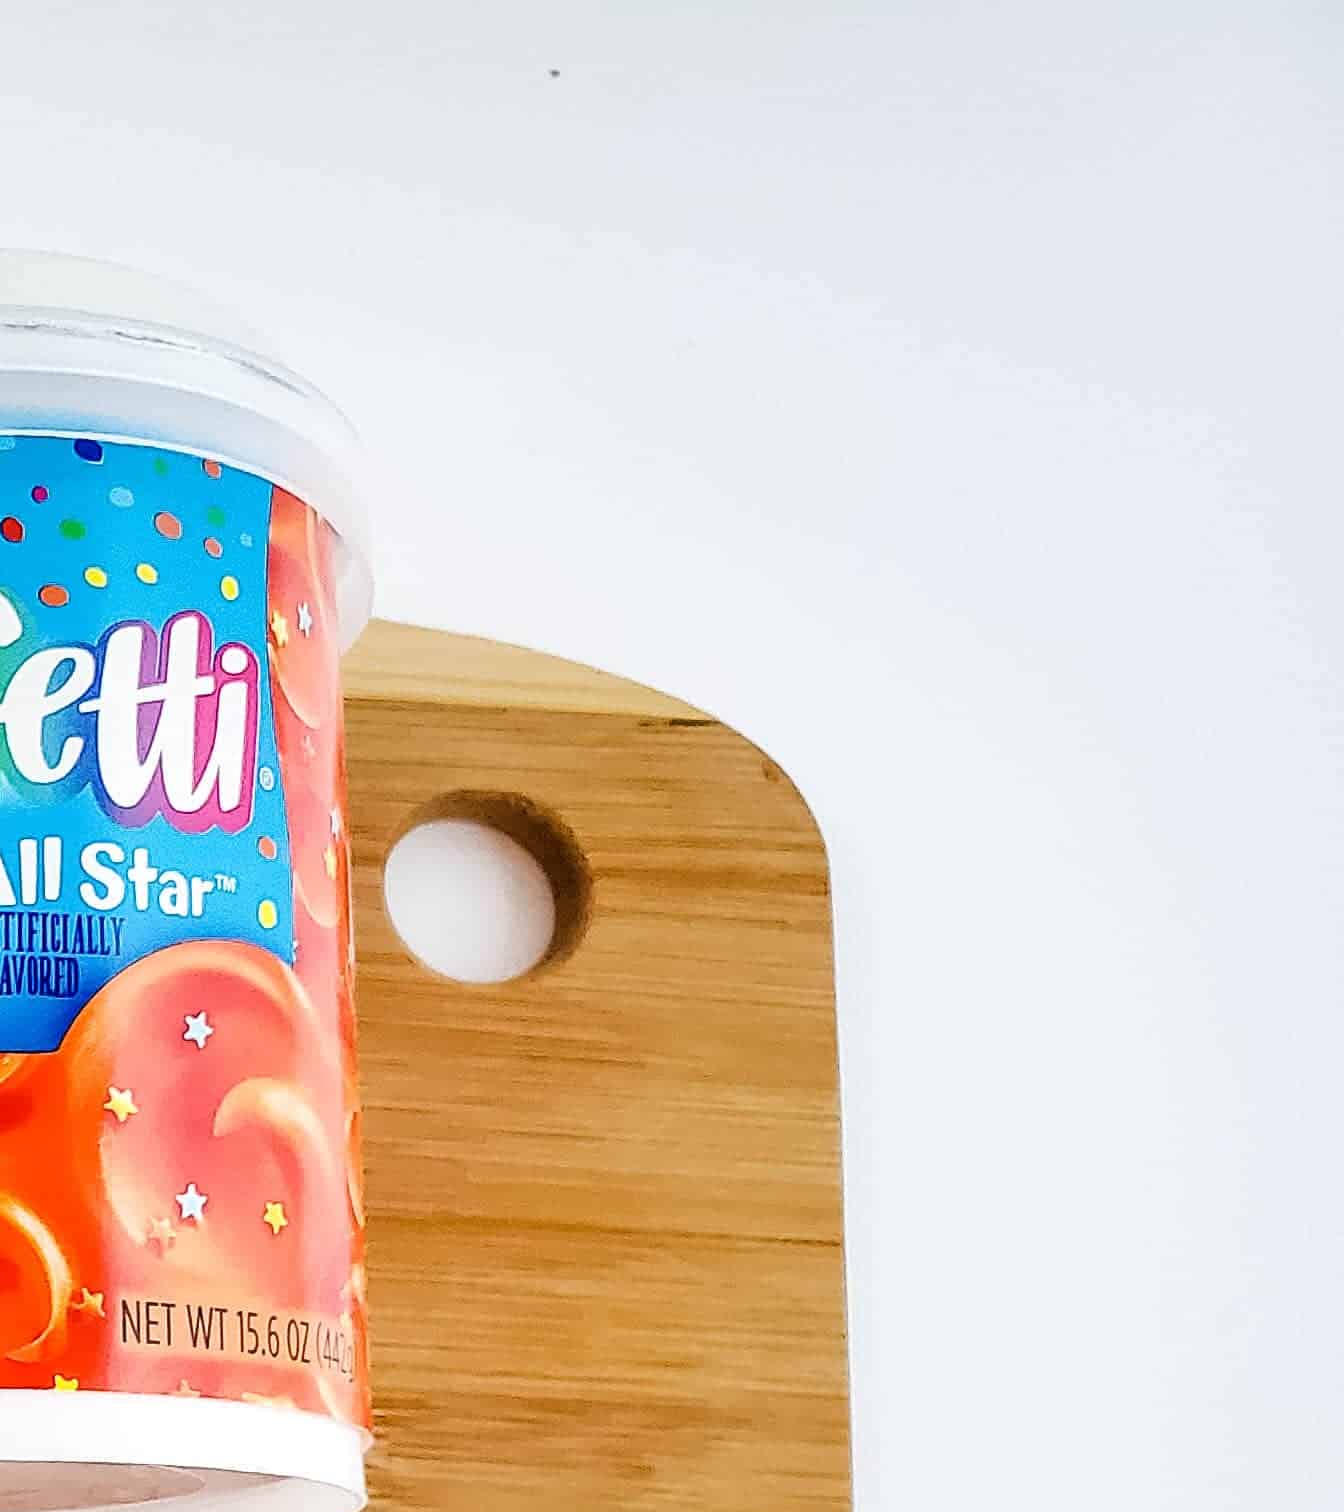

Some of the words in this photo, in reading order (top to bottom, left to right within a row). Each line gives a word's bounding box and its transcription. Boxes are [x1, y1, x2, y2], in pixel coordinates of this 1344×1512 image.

[120, 1299, 176, 1347] NET
[185, 1304, 229, 1351] WT
[236, 1310, 280, 1358] 15.6
[286, 1318, 312, 1364] OZ
